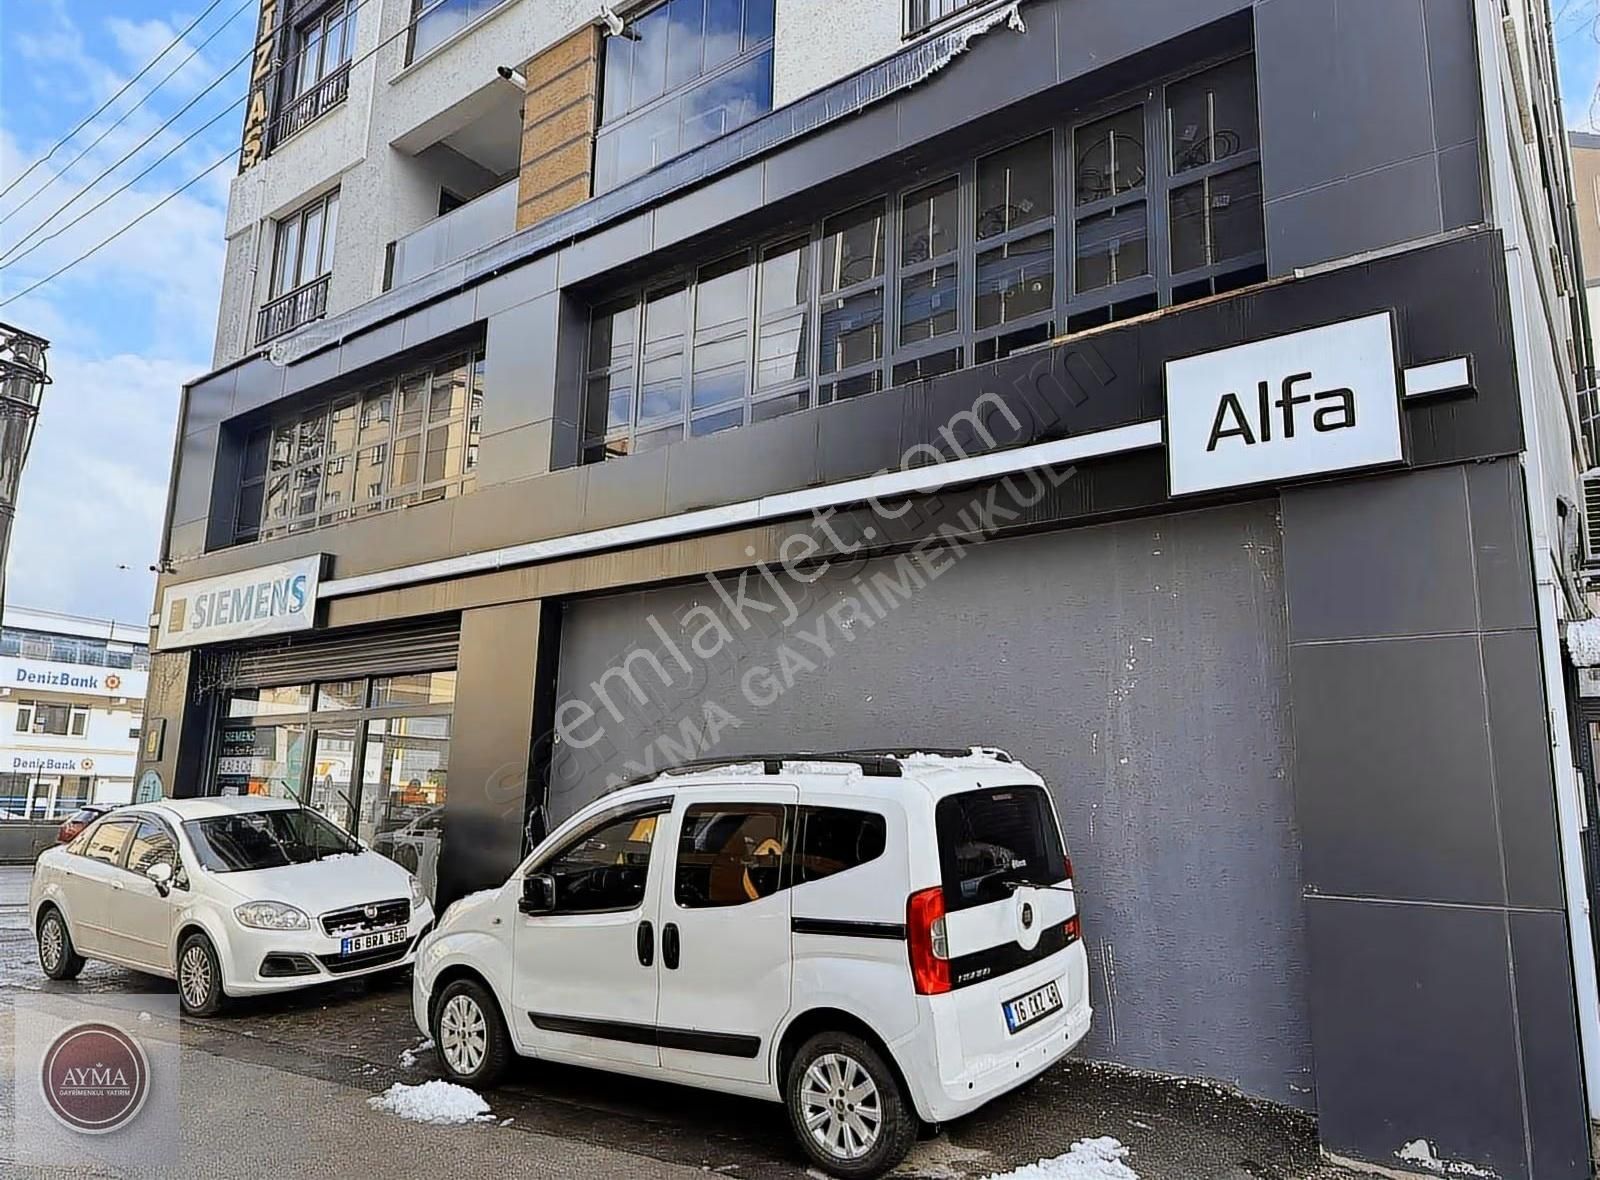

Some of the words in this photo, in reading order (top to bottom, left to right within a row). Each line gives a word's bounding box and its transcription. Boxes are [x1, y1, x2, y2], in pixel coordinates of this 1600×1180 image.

[1206, 371, 1356, 451] Alfa
[191, 574, 306, 630] SIEMENS
[16, 667, 99, 689] DenizBank
[12, 757, 77, 771] DenizBank
[349, 937, 361, 952] 16
[365, 933, 385, 949] BRA
[1014, 1001, 1028, 1023] 16
